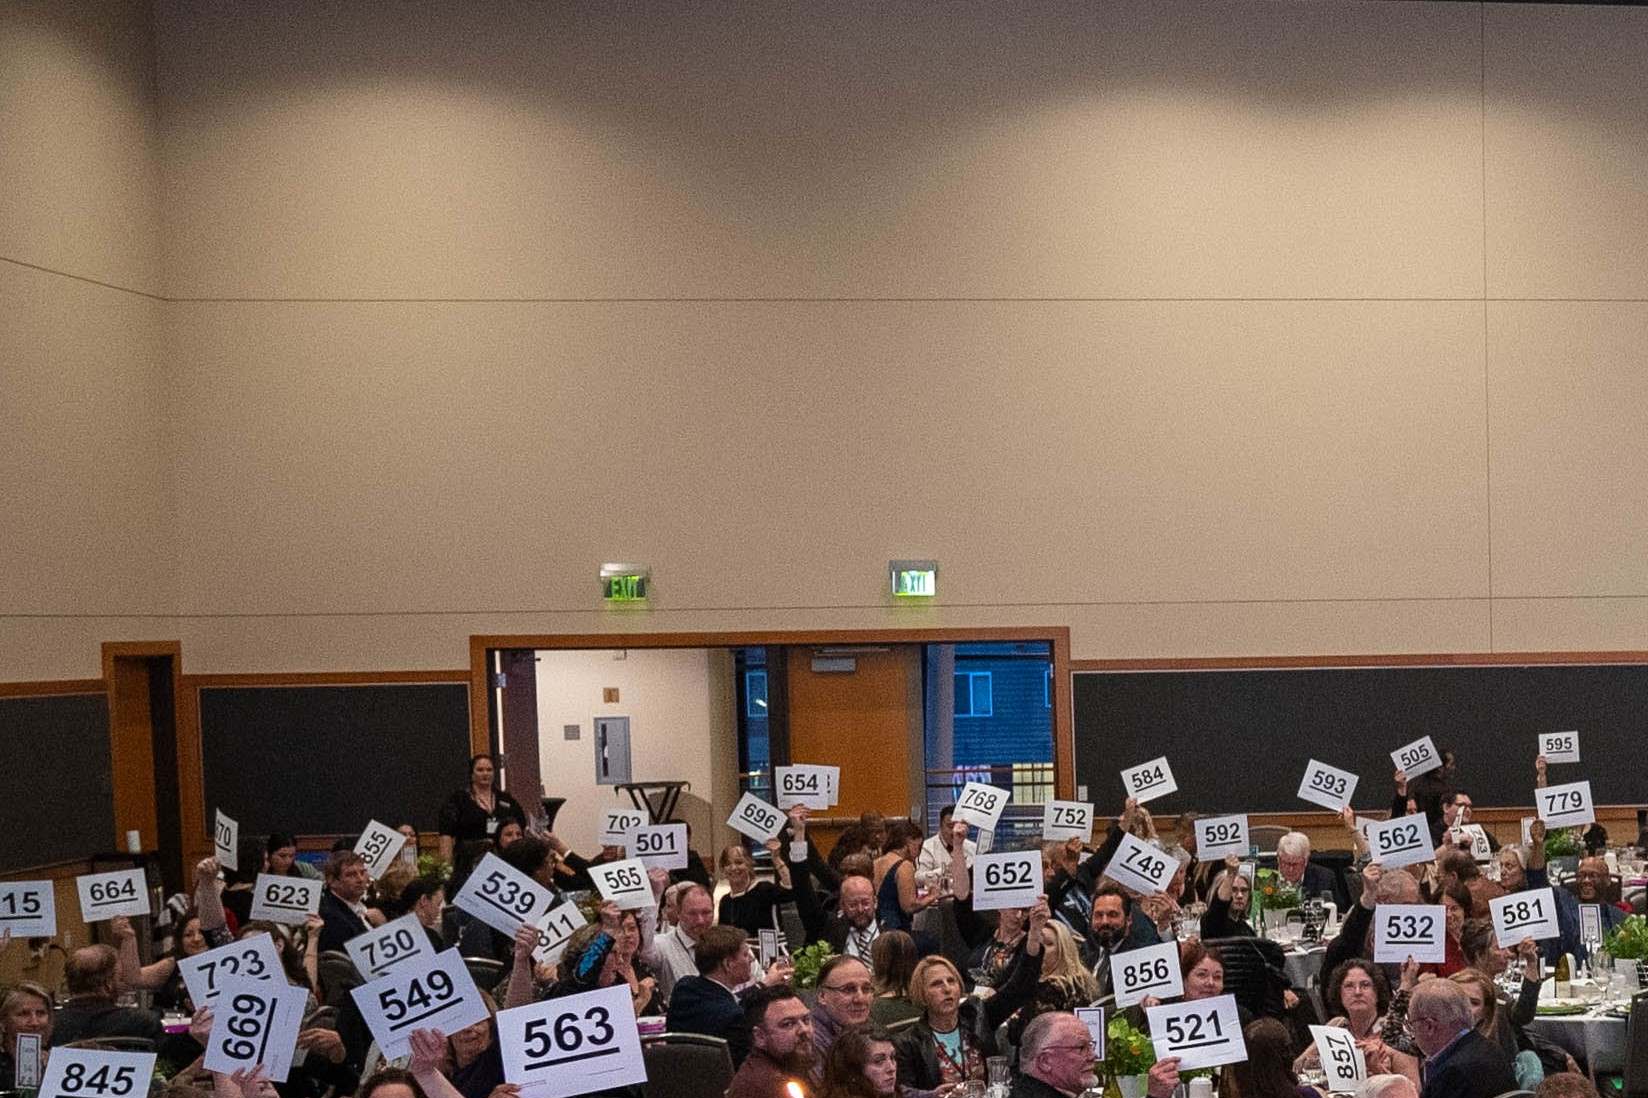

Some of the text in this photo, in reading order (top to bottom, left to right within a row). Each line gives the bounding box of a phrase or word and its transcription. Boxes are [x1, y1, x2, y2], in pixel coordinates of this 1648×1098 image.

[611, 578, 637, 597] EXIT
[1401, 744, 1429, 766] 505
[1546, 737, 1572, 750] 595
[783, 774, 818, 791] 654
[1132, 766, 1163, 788] 584
[1312, 770, 1346, 794] 593
[964, 789, 997, 810] 768
[1545, 791, 1582, 812] 779
[744, 803, 777, 828] 696
[1054, 807, 1086, 825] 752
[637, 832, 674, 852] 501
[1206, 823, 1240, 842] 592
[1379, 824, 1420, 849] 562
[361, 831, 386, 864] 855
[986, 861, 1032, 885] 652
[1126, 846, 1165, 879] 748
[90, 878, 136, 901] 664
[604, 867, 641, 889] 565
[3, 891, 40, 914] 15
[266, 884, 309, 906] 623
[482, 871, 535, 914] 539
[1503, 899, 1543, 924] 581
[537, 914, 575, 947] 811
[1387, 916, 1433, 938] 532
[360, 930, 414, 966] 750
[1124, 958, 1168, 986] 856
[378, 970, 454, 1020] 549
[222, 994, 266, 1060] 669
[525, 1007, 614, 1058] 563
[1167, 1010, 1222, 1043] 521
[1332, 1036, 1355, 1079] 857
[61, 1063, 135, 1095] 845
